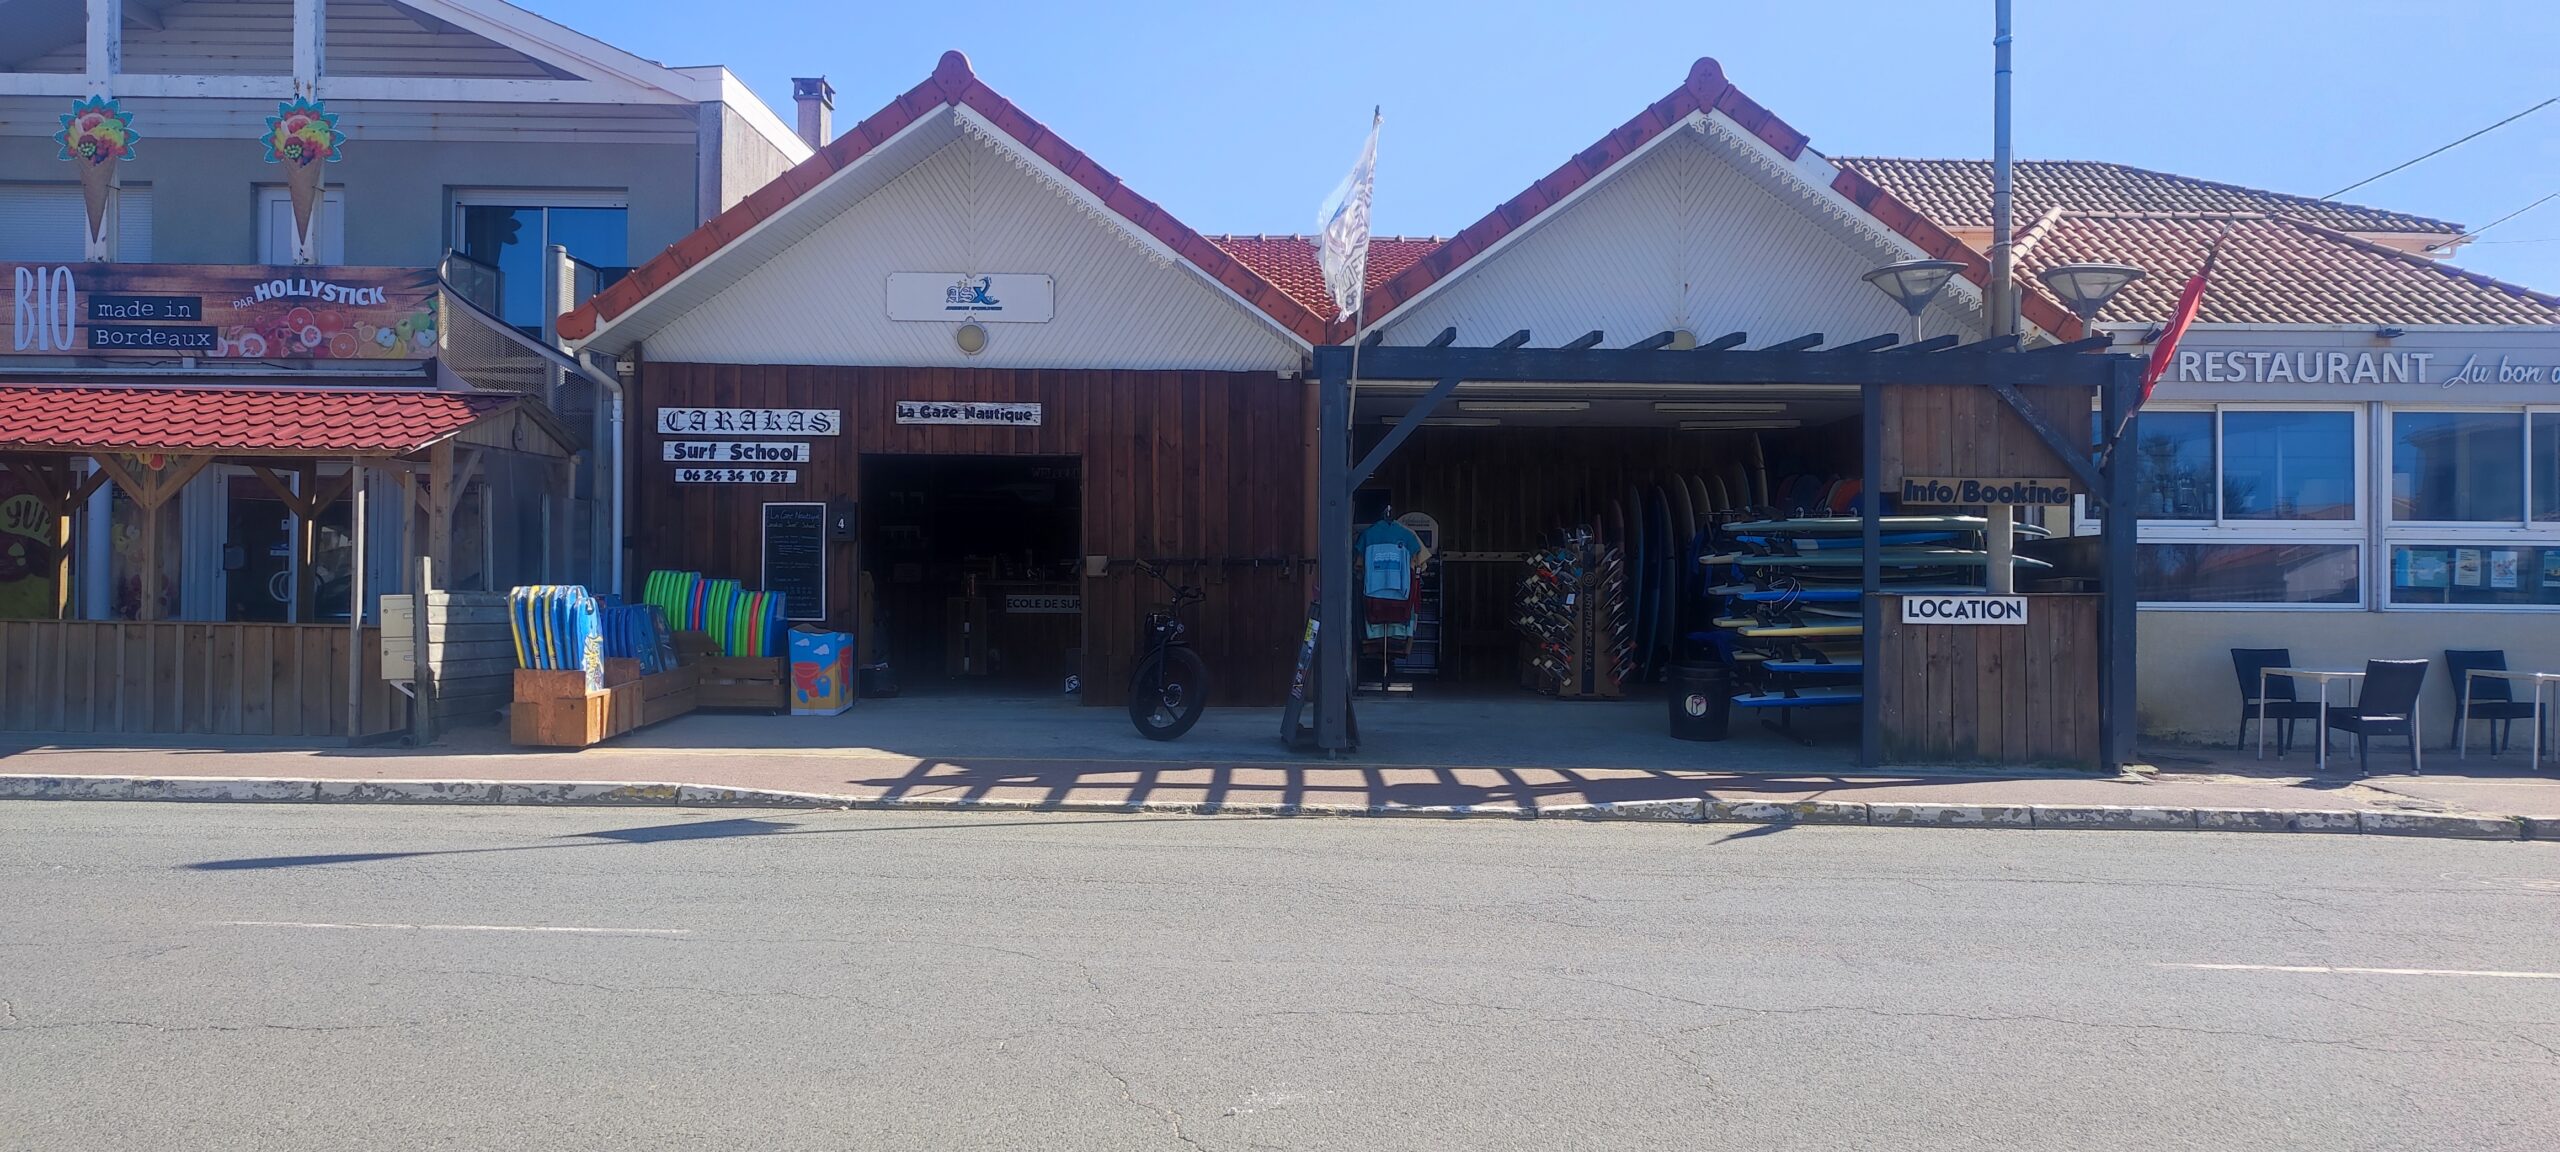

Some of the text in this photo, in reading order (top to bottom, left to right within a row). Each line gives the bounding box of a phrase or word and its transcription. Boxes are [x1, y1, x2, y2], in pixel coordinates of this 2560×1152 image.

[232, 278, 387, 311] PAR HOLLYSTICK
[15, 265, 76, 351] BIO
[98, 300, 191, 318] made in
[96, 328, 211, 346] Bordeaux
[2179, 350, 2435, 384] RESTAURANT
[2441, 353, 2491, 389] Au
[2499, 354, 2544, 383] bon
[898, 404, 915, 418] La
[665, 409, 832, 433] CARAKAS
[673, 442, 799, 461] Surf School
[683, 469, 788, 483] 06 24 34 10 27
[837, 518, 845, 529] 4
[1007, 599, 1041, 609] ECOLE
[1044, 599, 1057, 609] DE
[1907, 599, 2022, 619] LOCATION
